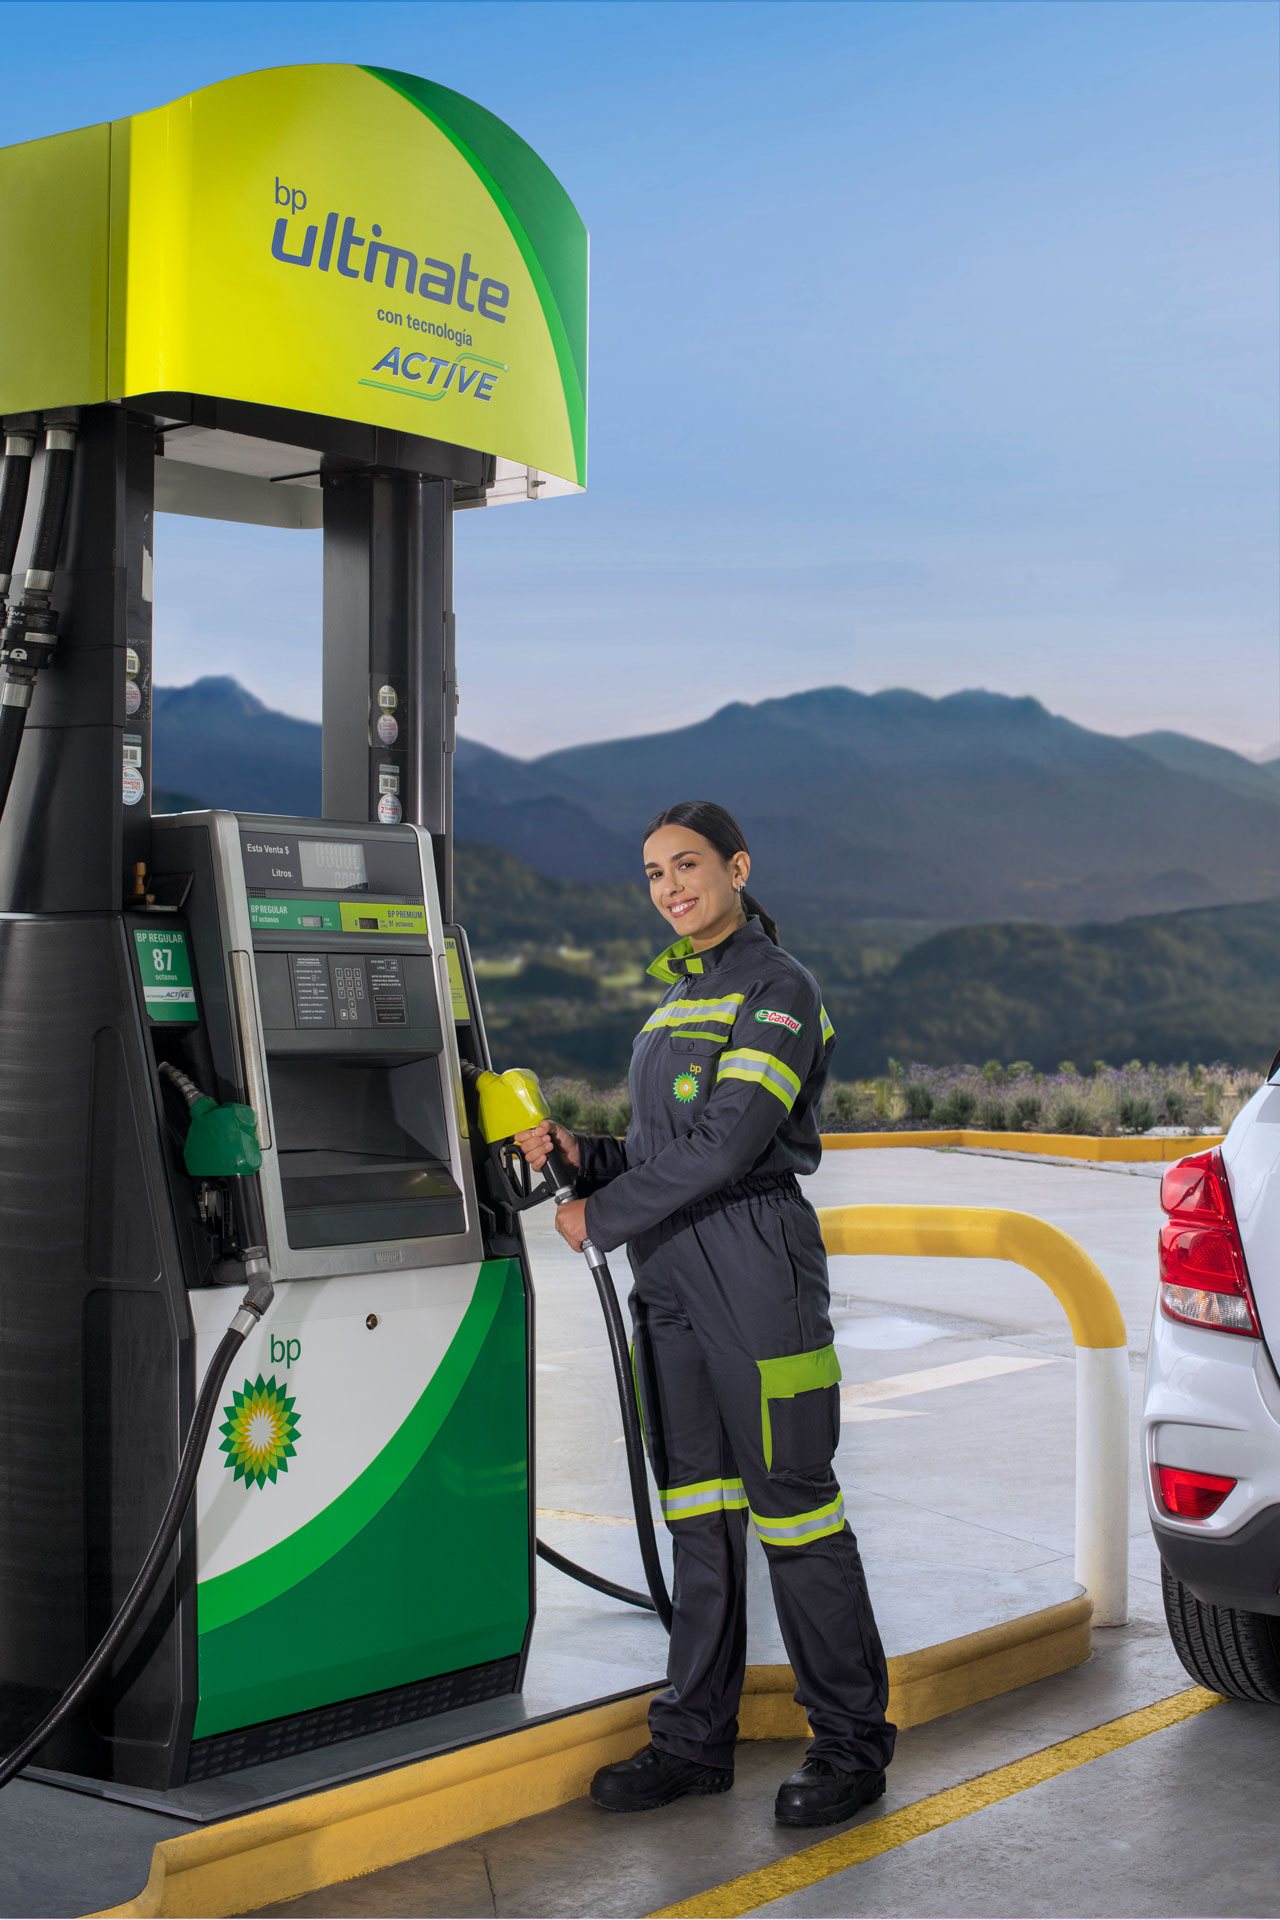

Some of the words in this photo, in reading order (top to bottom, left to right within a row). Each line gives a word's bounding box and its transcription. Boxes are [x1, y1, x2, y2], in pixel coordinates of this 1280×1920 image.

[275, 176, 307, 215] bp
[271, 212, 510, 324] ultimate
[377, 308, 403, 326] con
[406, 314, 473, 347] tecnología
[371, 346, 499, 402] ACTIVE
[247, 843, 263, 853] Esta
[264, 845, 284, 854] Venta
[284, 846, 290, 855] $
[250, 904, 260, 913] BP
[259, 905, 288, 914] REGULAR
[387, 910, 395, 918] BP
[396, 911, 423, 919] PREMIUM
[136, 932, 147, 942] BP
[148, 933, 183, 943] REGULAR
[152, 948, 173, 971] 87
[165, 991, 190, 999] ACTIVE
[768, 1011, 800, 1032] Castrol
[690, 1063, 701, 1075] bp
[271, 1333, 302, 1370] bp
